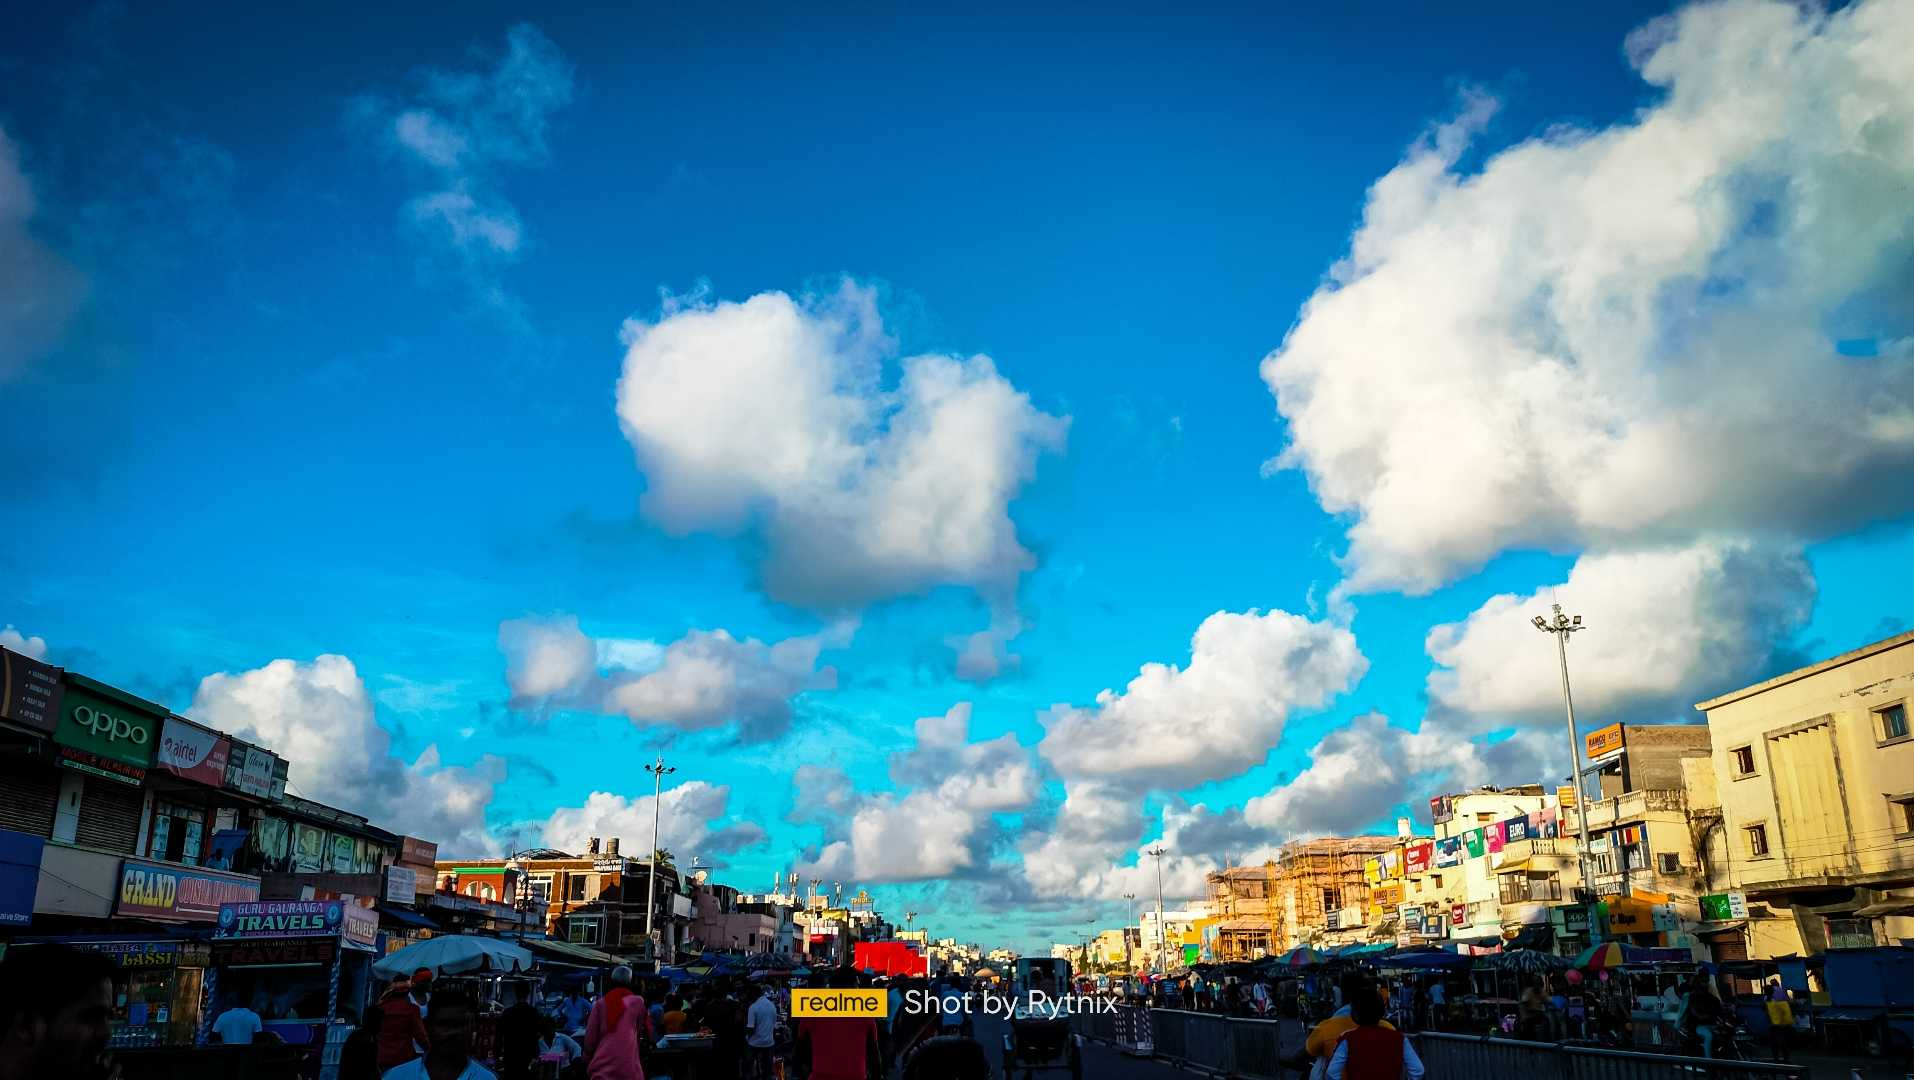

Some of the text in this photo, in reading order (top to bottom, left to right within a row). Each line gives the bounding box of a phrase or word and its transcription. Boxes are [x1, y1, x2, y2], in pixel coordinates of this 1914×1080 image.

[173, 740, 197, 762] airtel
[1509, 823, 1525, 838] EURO
[122, 870, 176, 908] GRAND
[268, 902, 323, 914] GAURANGA
[236, 915, 325, 931] TRAVELS
[349, 918, 374, 938] TRAVELS
[122, 952, 173, 968] LASSI
